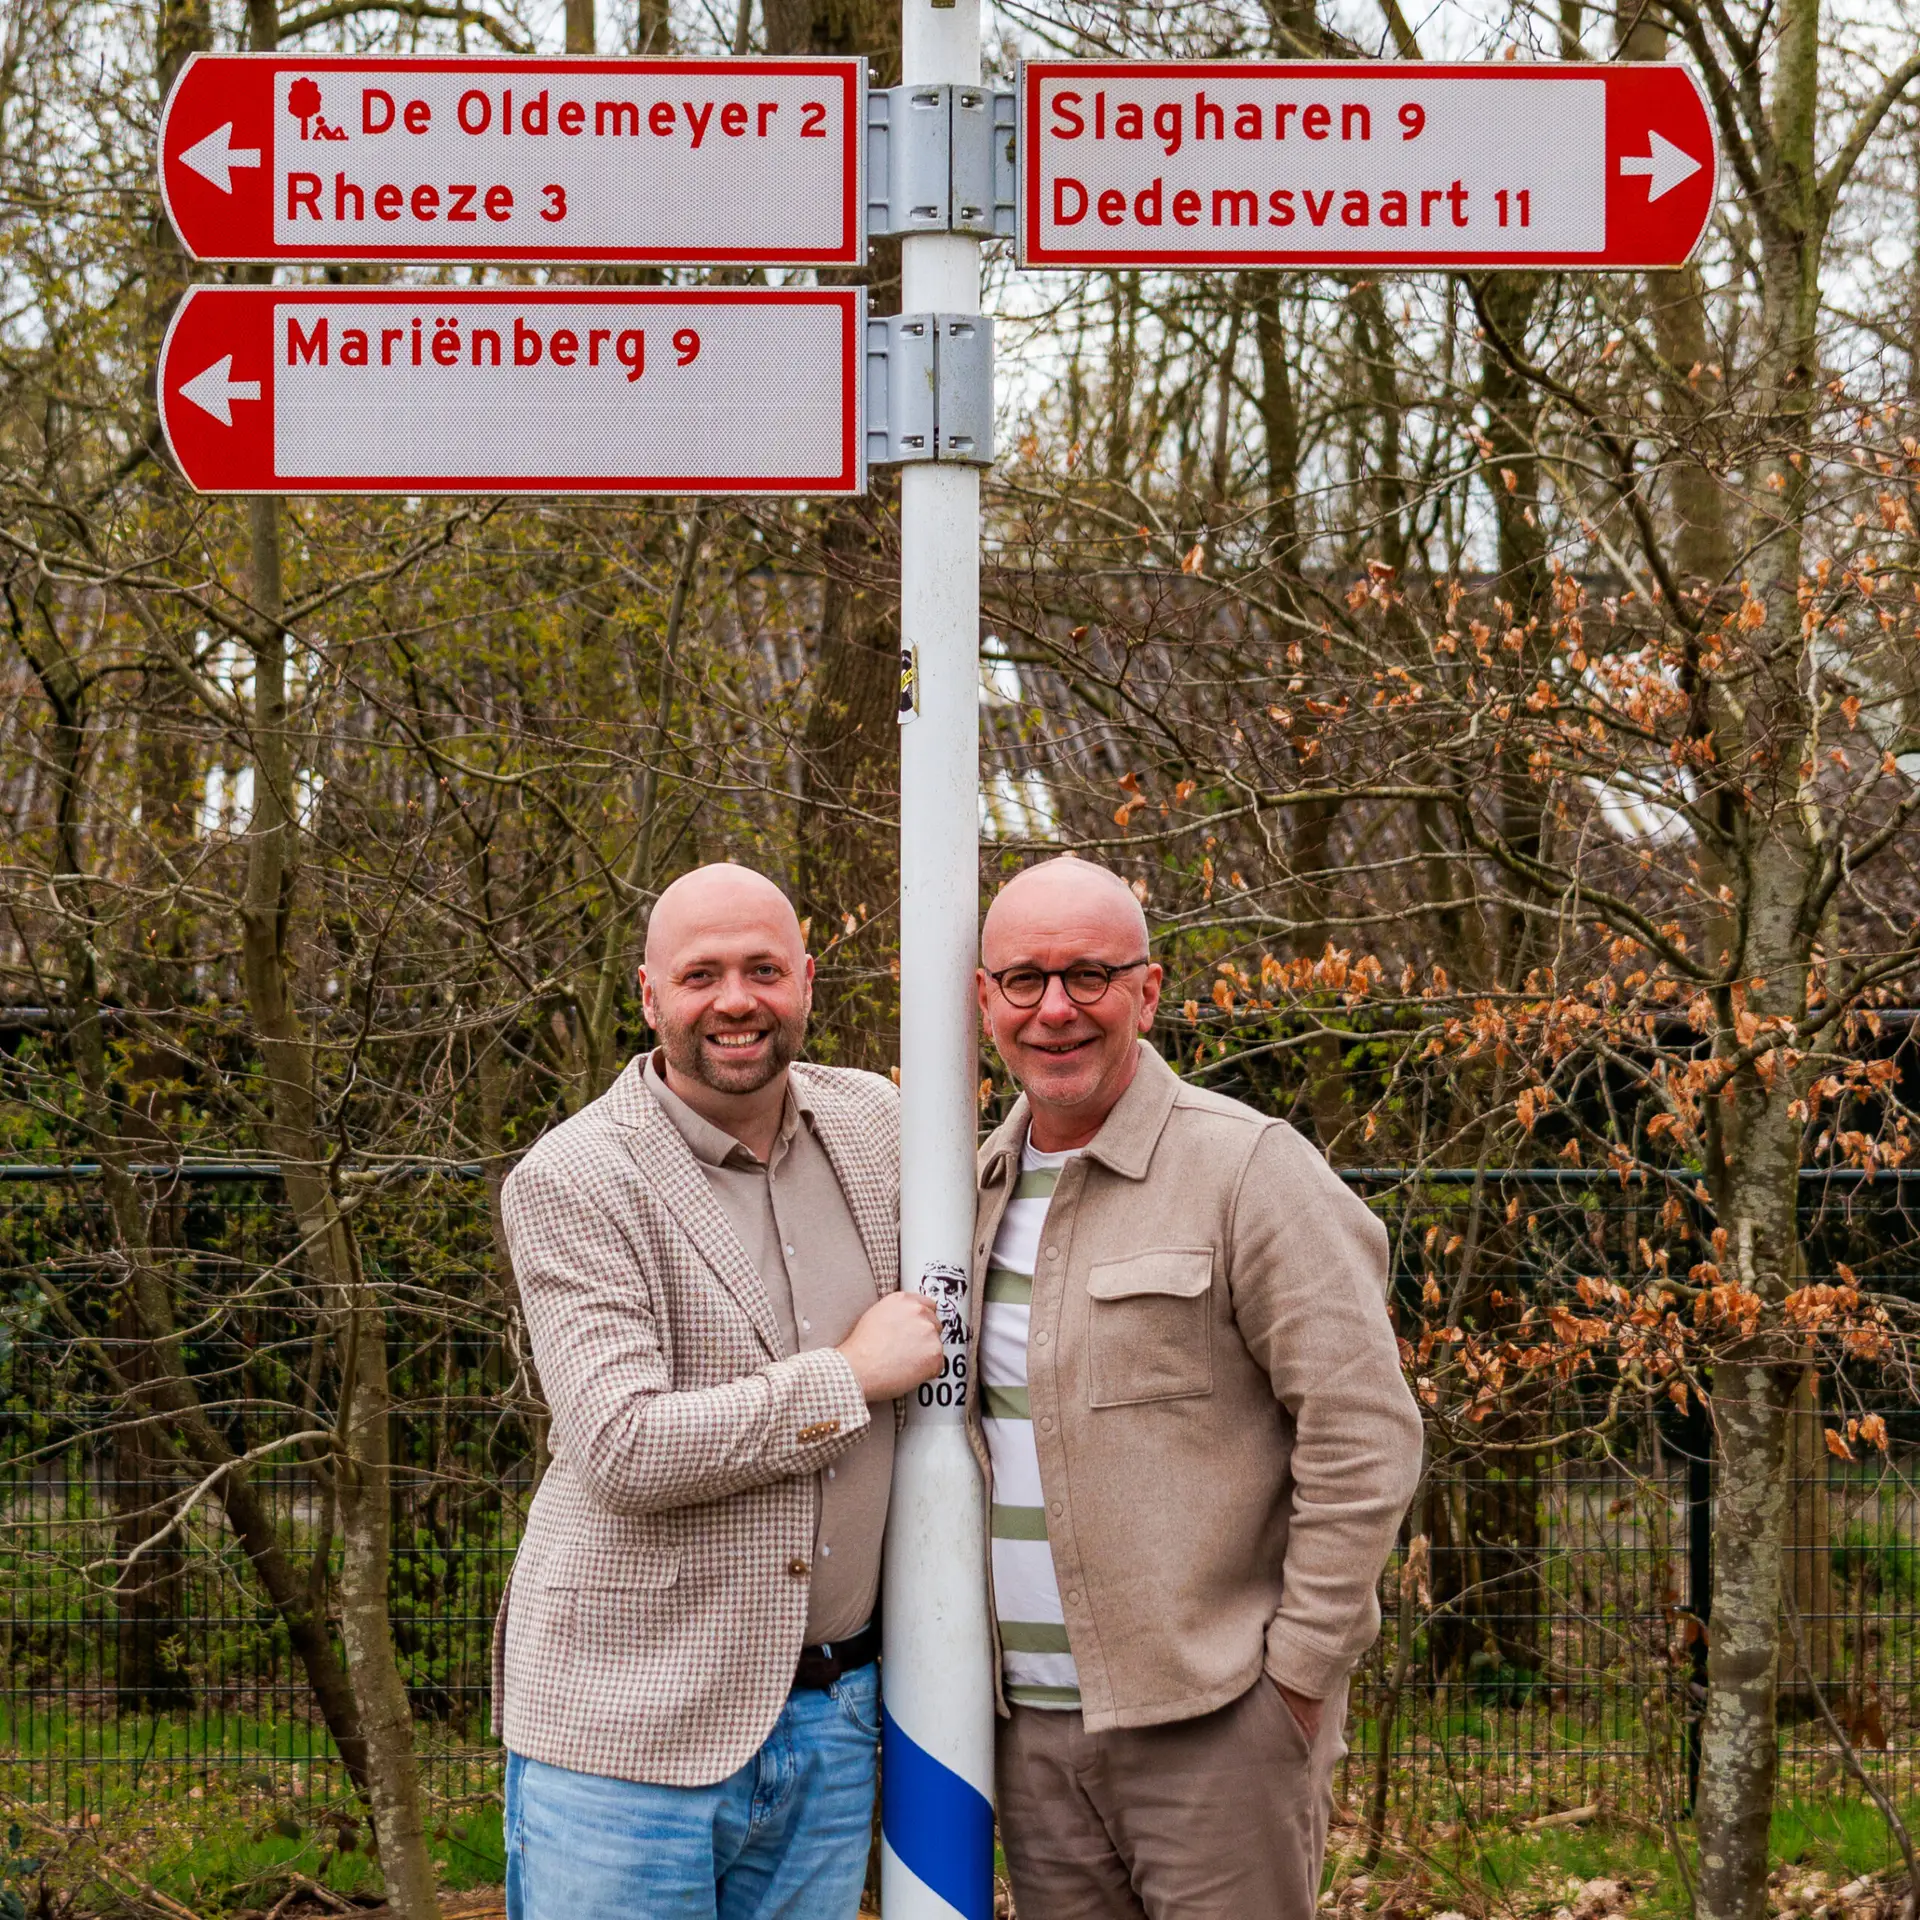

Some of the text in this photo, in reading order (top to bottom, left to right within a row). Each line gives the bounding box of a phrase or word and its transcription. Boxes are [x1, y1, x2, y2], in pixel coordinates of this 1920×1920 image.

[362, 88, 827, 149] De Oldemeyer 2
[1050, 91, 1426, 156] Slagharen 9
[288, 172, 567, 222] Rheeze 3
[1054, 178, 1530, 227] Dedemsvaart 11
[287, 318, 700, 382] Mariënberg 9
[918, 1381, 968, 1407] 002
